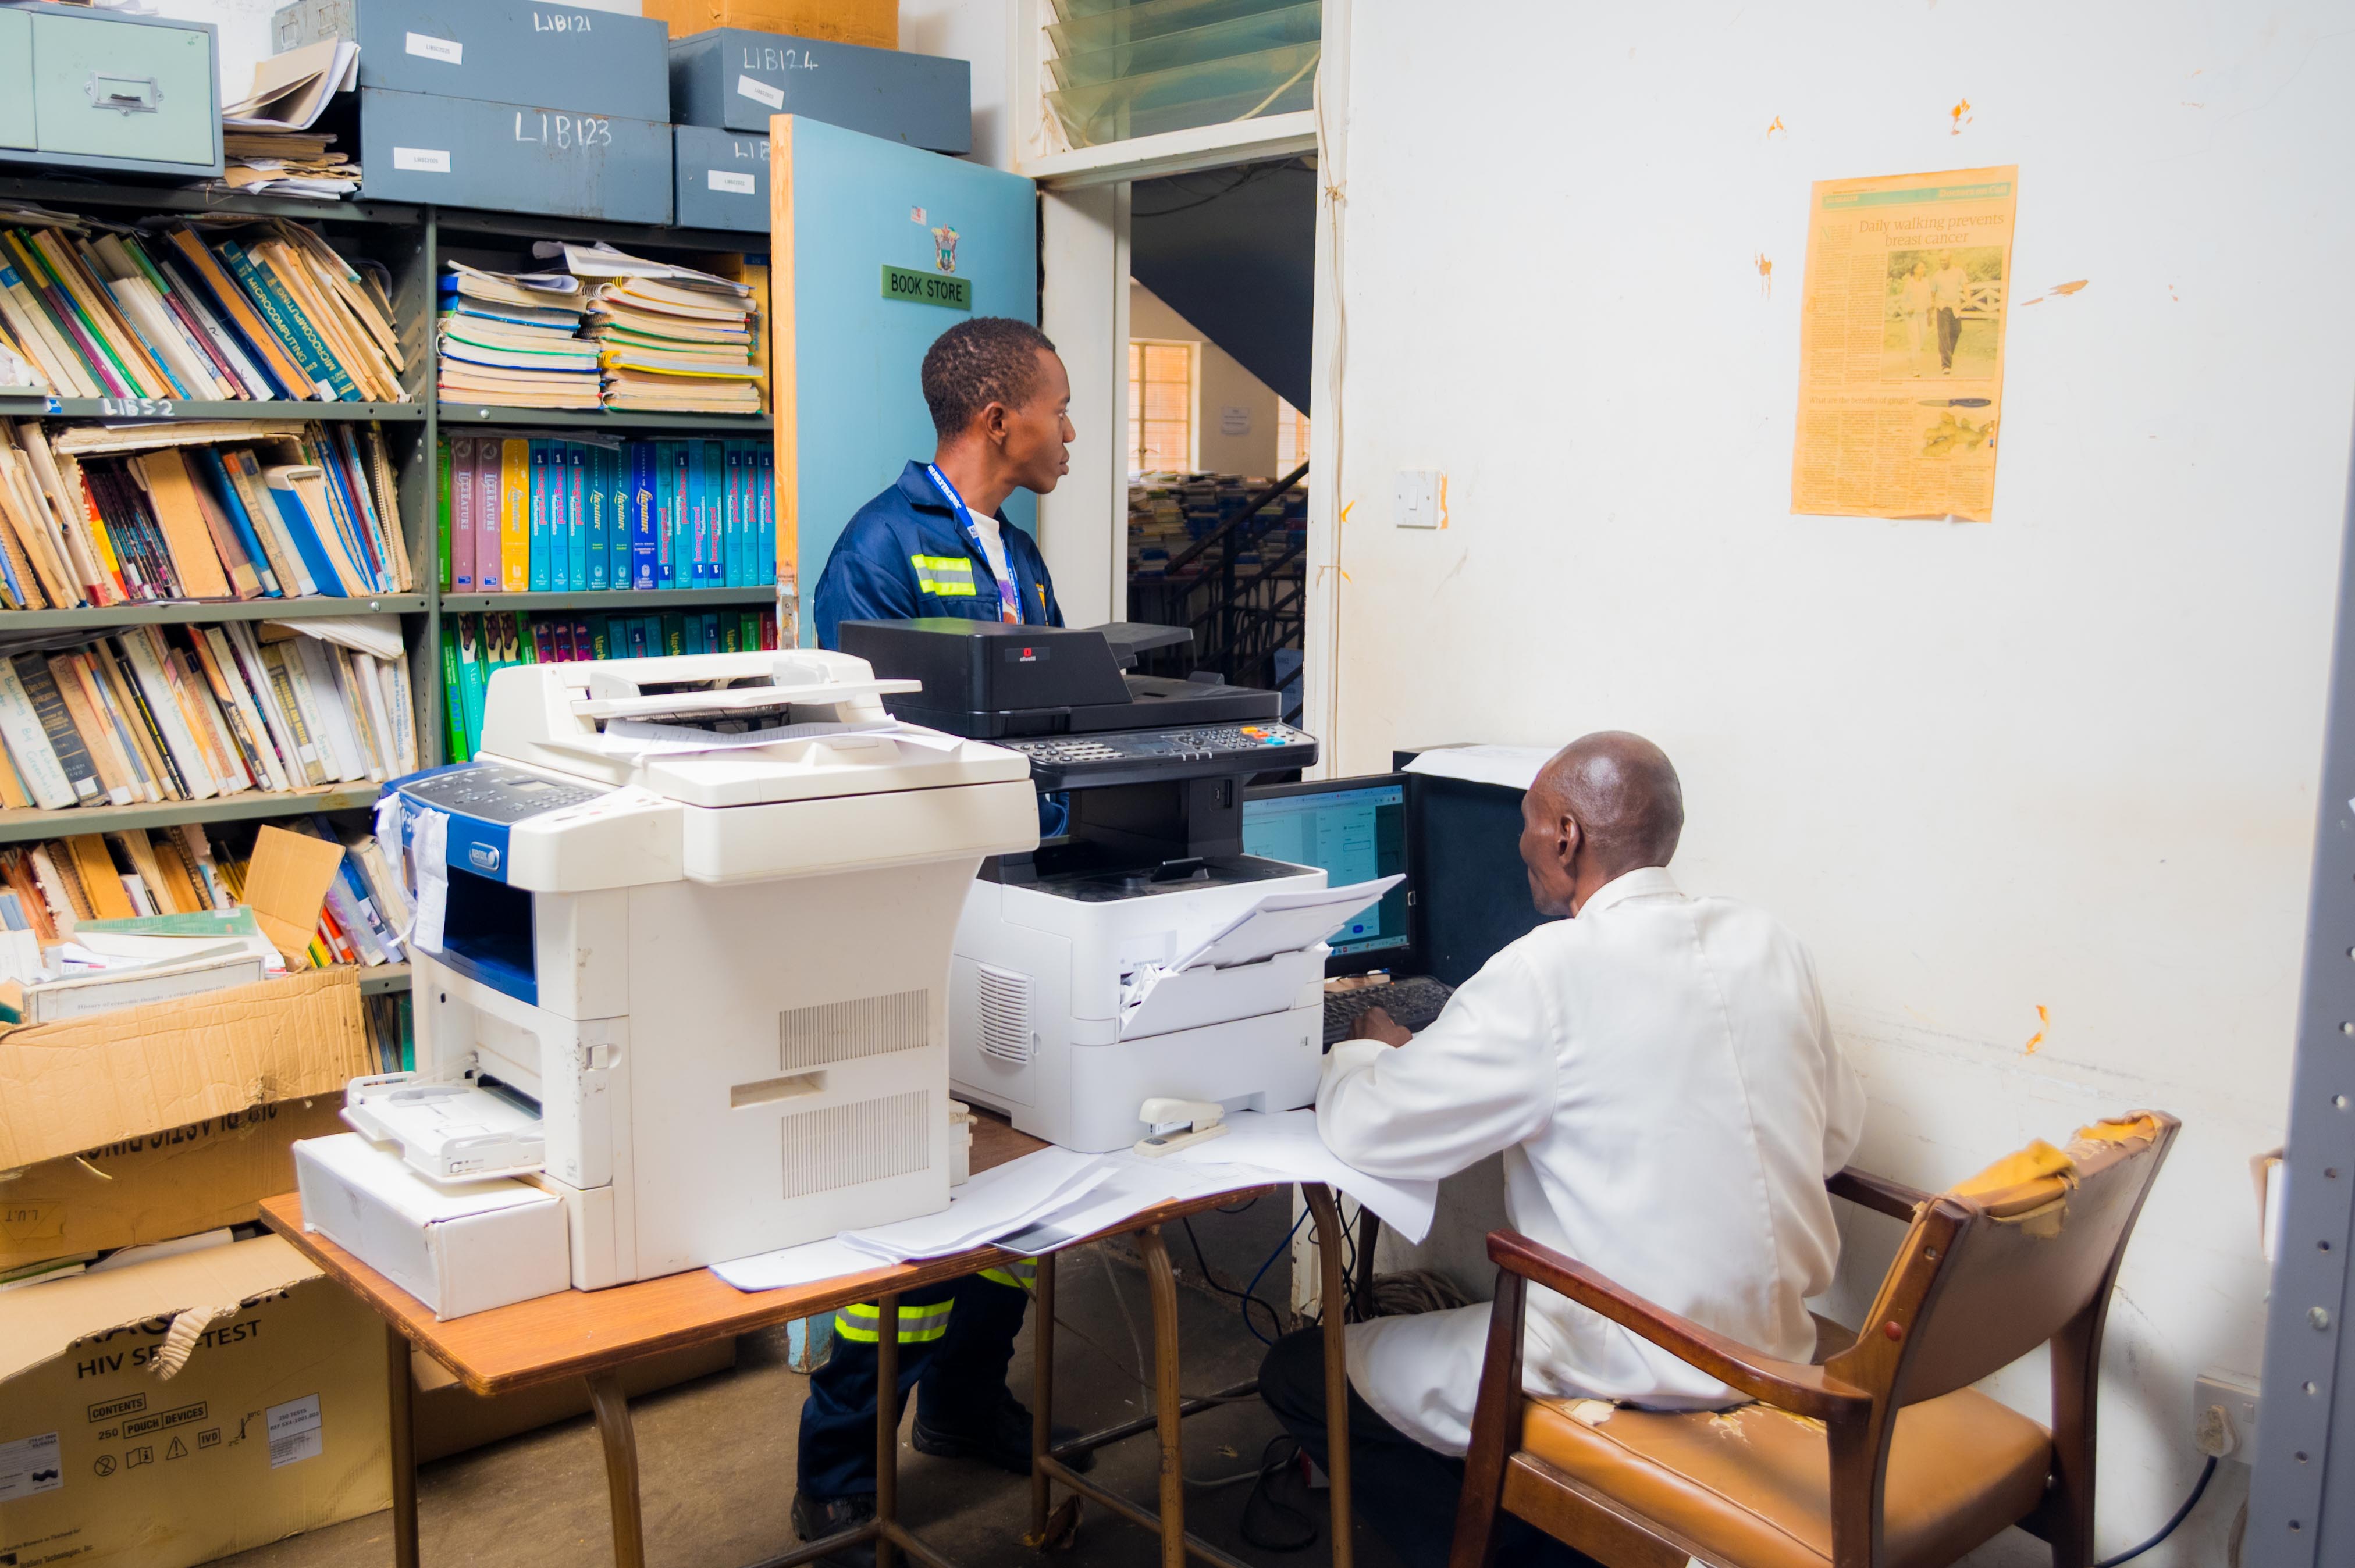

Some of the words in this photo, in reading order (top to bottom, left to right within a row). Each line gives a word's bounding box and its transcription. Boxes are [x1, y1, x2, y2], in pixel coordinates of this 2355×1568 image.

[534, 12, 592, 32] LIB121
[744, 47, 819, 70] LIB124
[515, 111, 612, 149] LIB123
[1859, 219, 1890, 234] Daily
[1894, 216, 1945, 231] walking
[1947, 213, 2005, 230] prevents
[1885, 234, 1922, 247] breast
[1924, 231, 1969, 244] cancer
[891, 273, 922, 296] BOOK
[927, 279, 963, 302] STORE
[247, 276, 308, 363] MICROCOMPUTING
[276, 287, 337, 372] MICROCOMPUTING
[1809, 396, 1826, 404] What
[1851, 396, 1879, 404] benefits
[1887, 396, 1914, 405] ginger?
[537, 454, 543, 464] 1
[556, 454, 561, 463] 1
[574, 455, 579, 464] 1
[680, 457, 685, 465] 1
[731, 456, 737, 464] 1
[748, 456, 753, 465] 1
[764, 457, 769, 465] 1
[458, 469, 472, 530] LITERATURE
[484, 472, 498, 532] LITERATURE
[536, 467, 547, 525] Integrated
[554, 466, 566, 524] Integrated
[572, 468, 584, 525] Integrated
[678, 469, 689, 525] Integrated
[730, 468, 741, 523] Integrated
[746, 468, 757, 522] Integrated
[763, 469, 773, 523] Integrated
[933, 469, 962, 509] POLYTECHNIC
[590, 489, 604, 530] Literature
[614, 489, 629, 531] Literature
[636, 486, 653, 534] Literature
[659, 507, 670, 564] Integrated
[692, 506, 704, 562] Integrated
[709, 507, 720, 562] Integrated
[663, 566, 669, 575] 1
[697, 564, 703, 573] 1
[713, 564, 718, 574] 1
[635, 633, 641, 642] 1
[709, 629, 714, 637] 1
[449, 685, 463, 732] MATH
[140, 995, 164, 1003] thought
[173, 989, 194, 997] critical
[5, 1209, 38, 1222] L.U.T
[78, 1352, 124, 1379] HIV
[133, 1319, 262, 1367] SE-TEST
[93, 1398, 143, 1419] CONTENTS
[290, 1408, 307, 1417] TESTS
[98, 1427, 119, 1441] 250
[127, 1418, 159, 1435] POUCH
[165, 1406, 204, 1425] DEVICES
[201, 1432, 218, 1444] IVD
